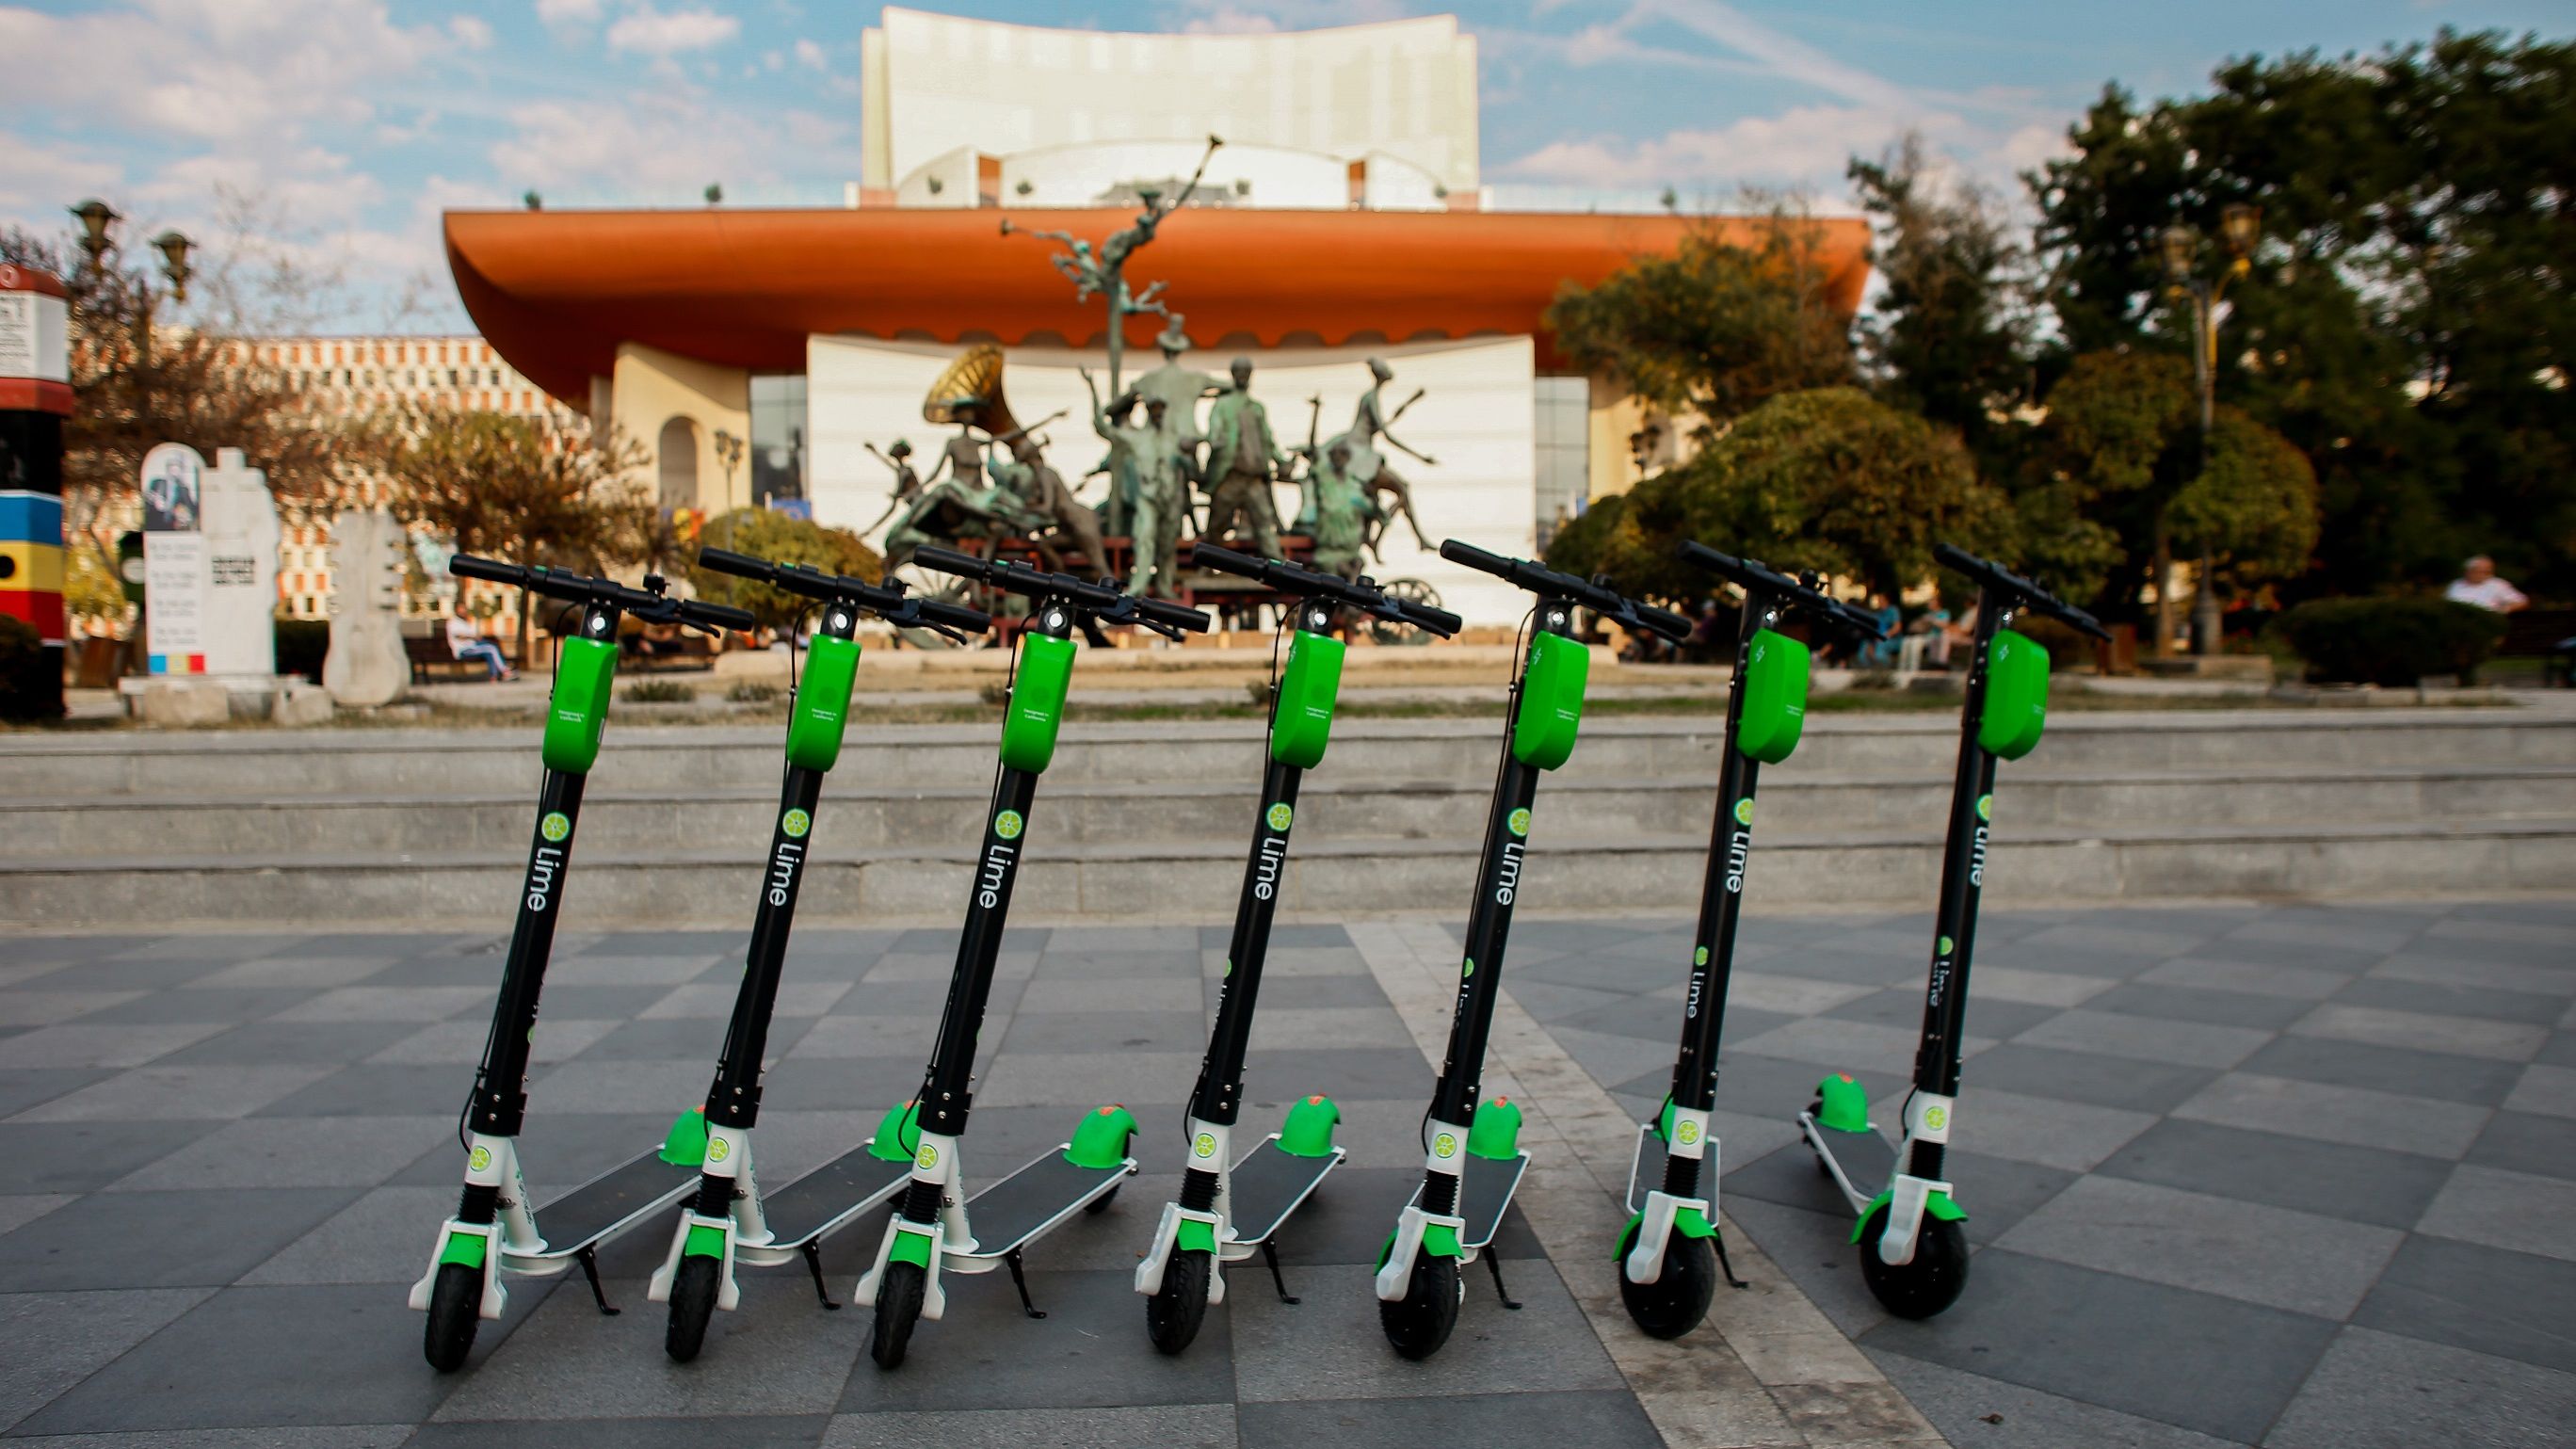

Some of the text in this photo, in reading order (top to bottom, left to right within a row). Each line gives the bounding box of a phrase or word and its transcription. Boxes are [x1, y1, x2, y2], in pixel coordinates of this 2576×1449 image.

[527, 847, 562, 911] Lime
[769, 843, 802, 906] Lime
[979, 845, 1014, 910] Lime
[1255, 837, 1286, 900] Lime
[1496, 843, 1524, 905] Lime
[1726, 830, 1749, 894] Lime
[1687, 972, 1705, 1019] Lime
